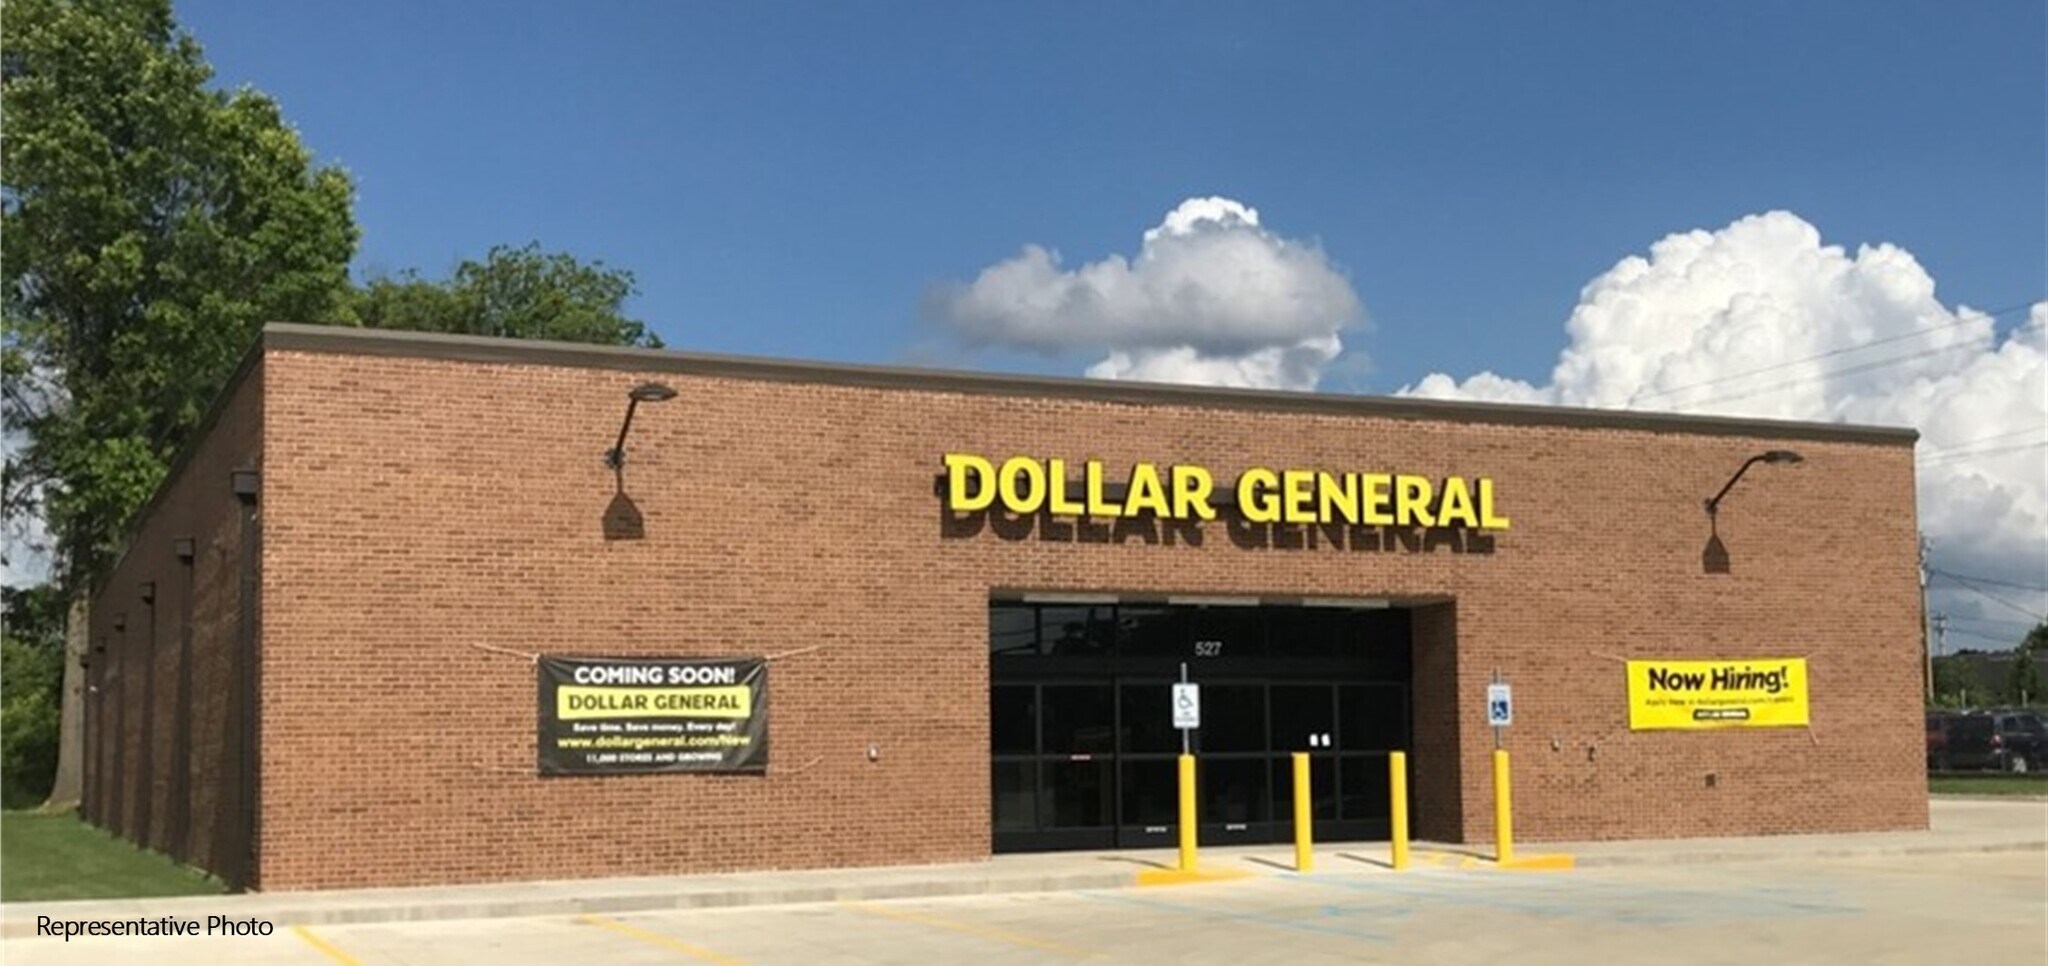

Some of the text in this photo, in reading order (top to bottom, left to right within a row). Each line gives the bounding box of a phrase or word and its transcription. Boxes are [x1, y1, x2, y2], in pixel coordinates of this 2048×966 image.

[945, 454, 1510, 529] DOLLAR GENERAL
[1195, 641, 1222, 656] 527
[574, 666, 735, 684] COMING SOON!
[1648, 666, 1789, 693] Now Hiring!
[568, 694, 740, 710] DOLLAR GENERAL
[573, 722, 597, 732] Save
[626, 722, 649, 732] Save
[655, 752, 676, 762] AND
